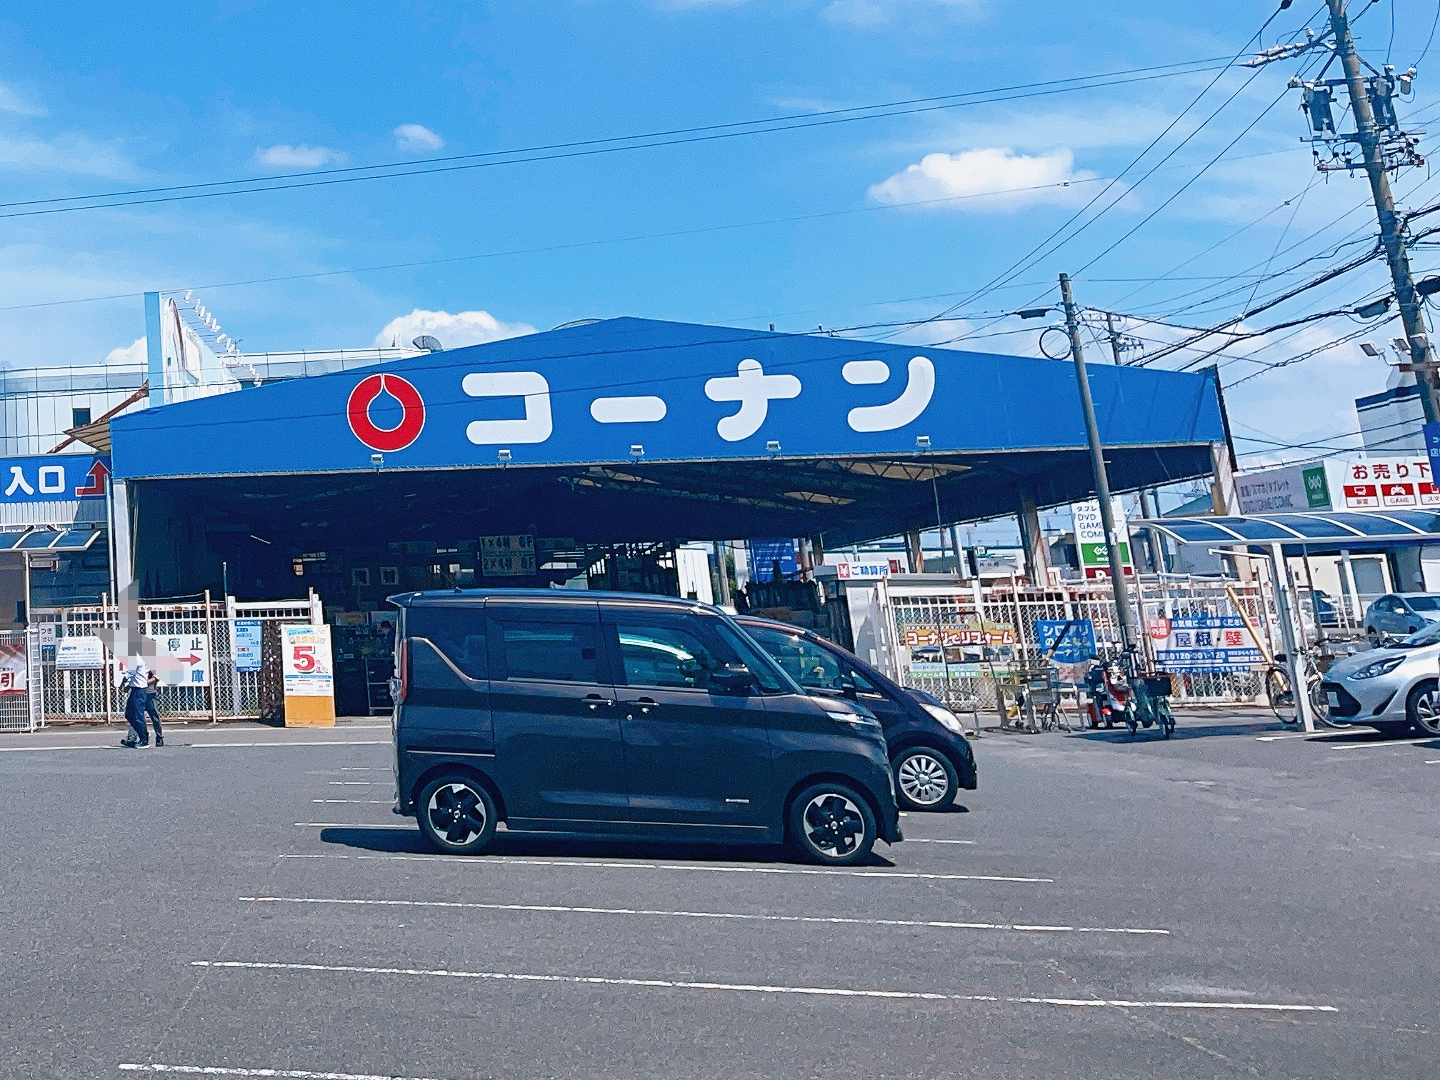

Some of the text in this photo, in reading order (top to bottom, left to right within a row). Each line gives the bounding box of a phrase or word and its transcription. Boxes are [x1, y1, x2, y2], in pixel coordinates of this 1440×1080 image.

[461, 355, 936, 445] コーナン
[1351, 462, 1430, 480] お売り下
[1077, 513, 1097, 522] DVD
[293, 645, 316, 674] 5
